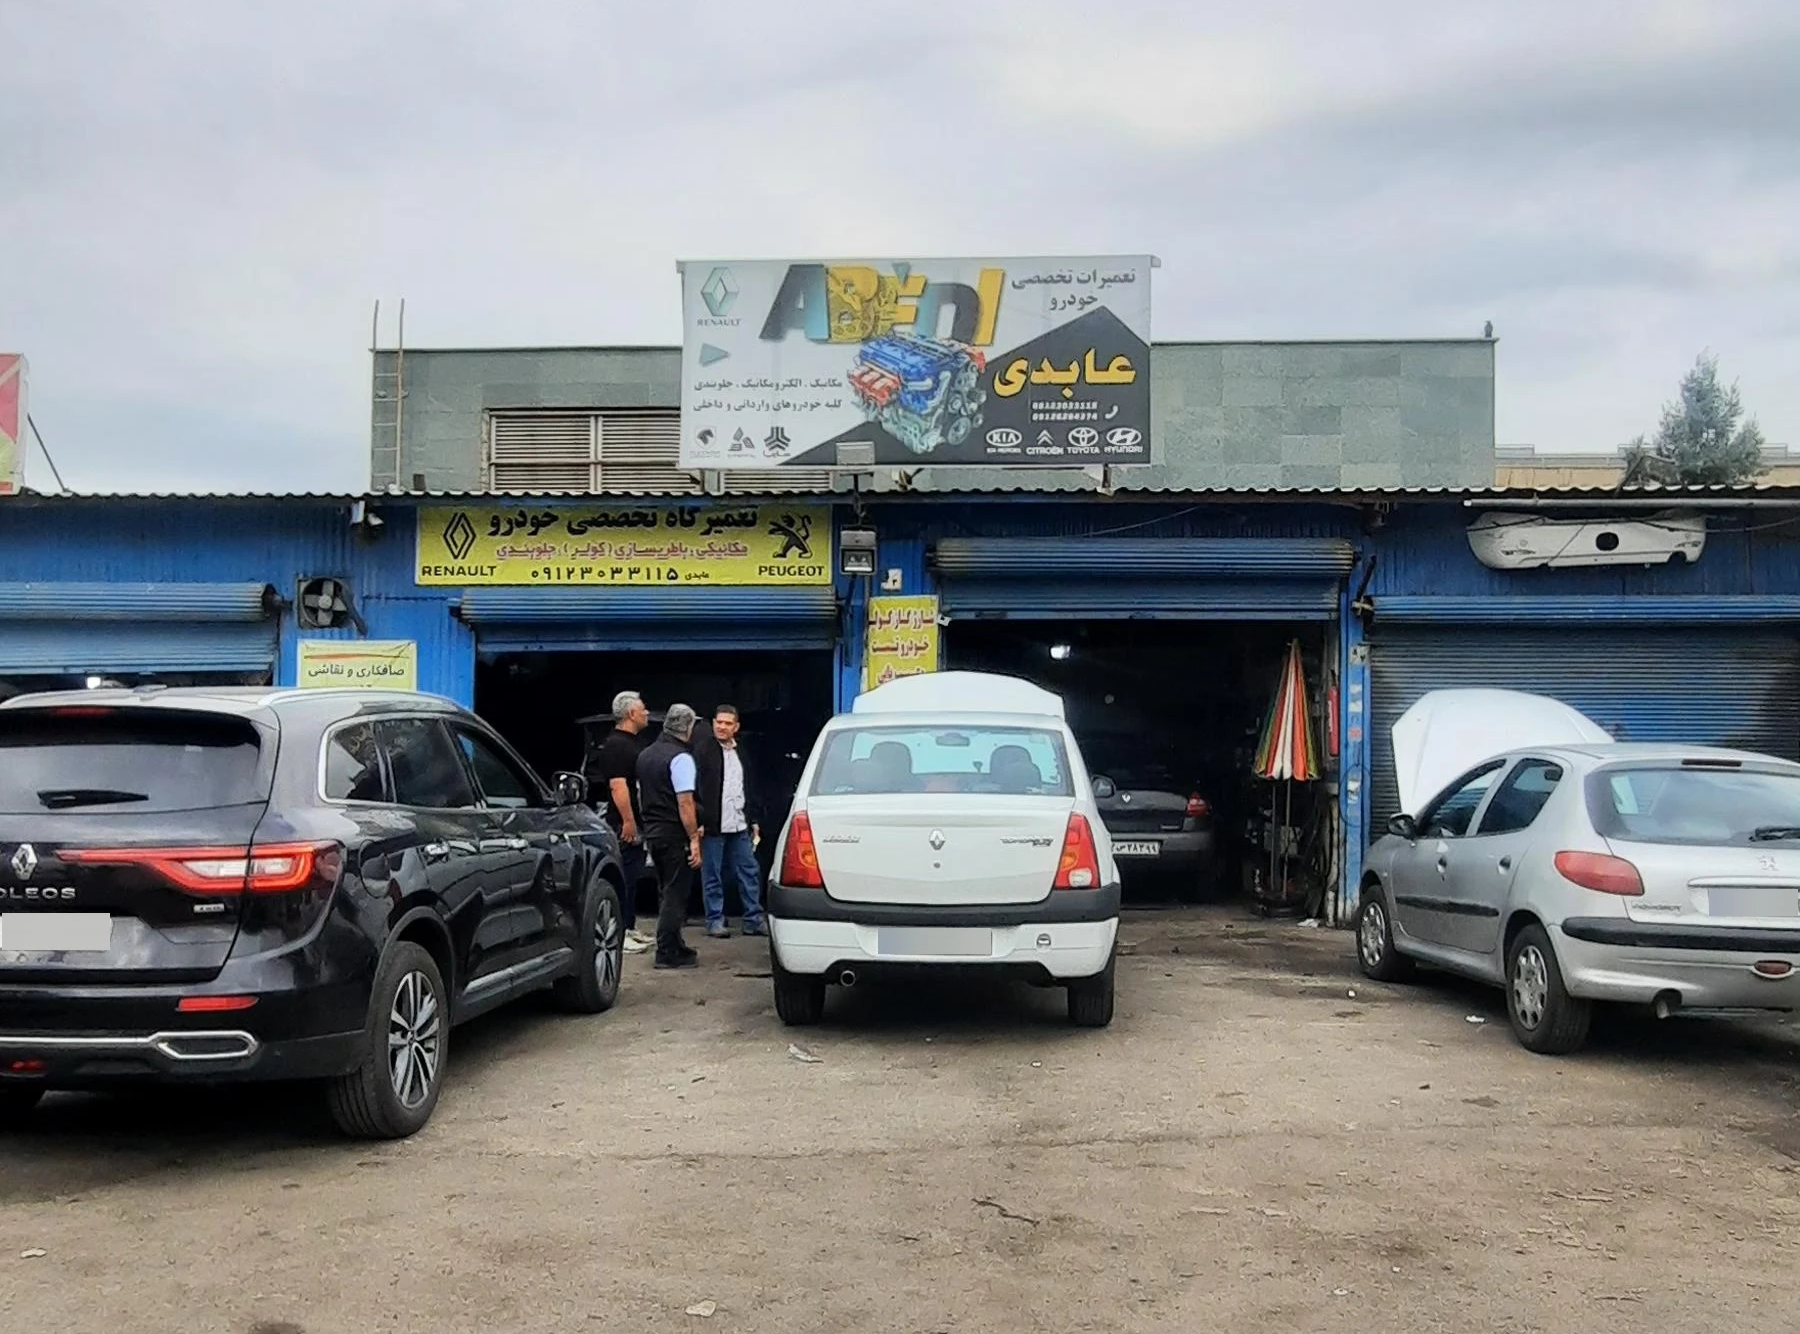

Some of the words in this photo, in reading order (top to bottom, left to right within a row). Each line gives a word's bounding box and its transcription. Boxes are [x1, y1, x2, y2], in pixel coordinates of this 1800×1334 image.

[1012, 268, 1073, 289] تخصصی
[1077, 268, 1136, 288] تعمیرات
[1050, 291, 1098, 311] خودرو
[697, 319, 742, 327] RENAULT
[992, 347, 1137, 398] عابدی
[992, 432, 1017, 443] KIA
[1067, 446, 1100, 455] TOYOTA
[487, 506, 559, 536] خودرو
[421, 565, 497, 577] RENAULT
[758, 565, 825, 577] PEUGEOT
[308, 664, 344, 677] نقاشی
[347, 668, 353, 677] و
[356, 664, 405, 678] صافکاری
